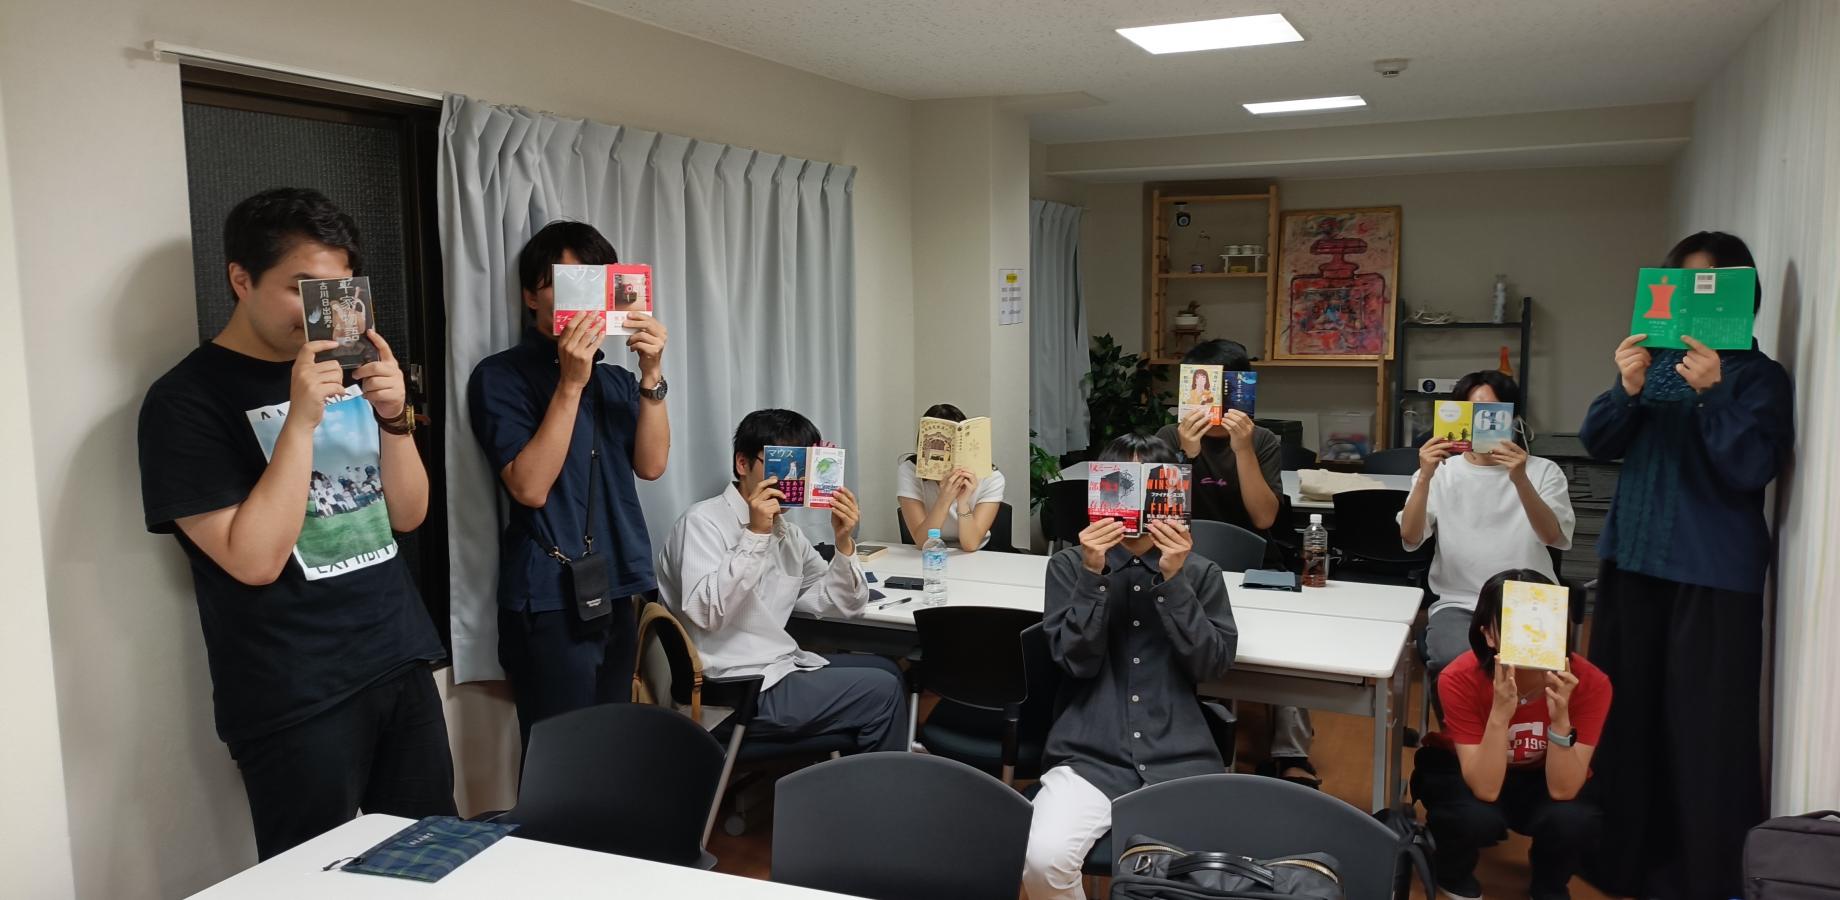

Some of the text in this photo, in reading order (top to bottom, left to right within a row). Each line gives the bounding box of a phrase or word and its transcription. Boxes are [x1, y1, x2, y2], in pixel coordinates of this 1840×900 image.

[338, 277, 360, 344] 平家物語
[768, 449, 794, 458] マウス
[1147, 479, 1190, 490] WINSOW
